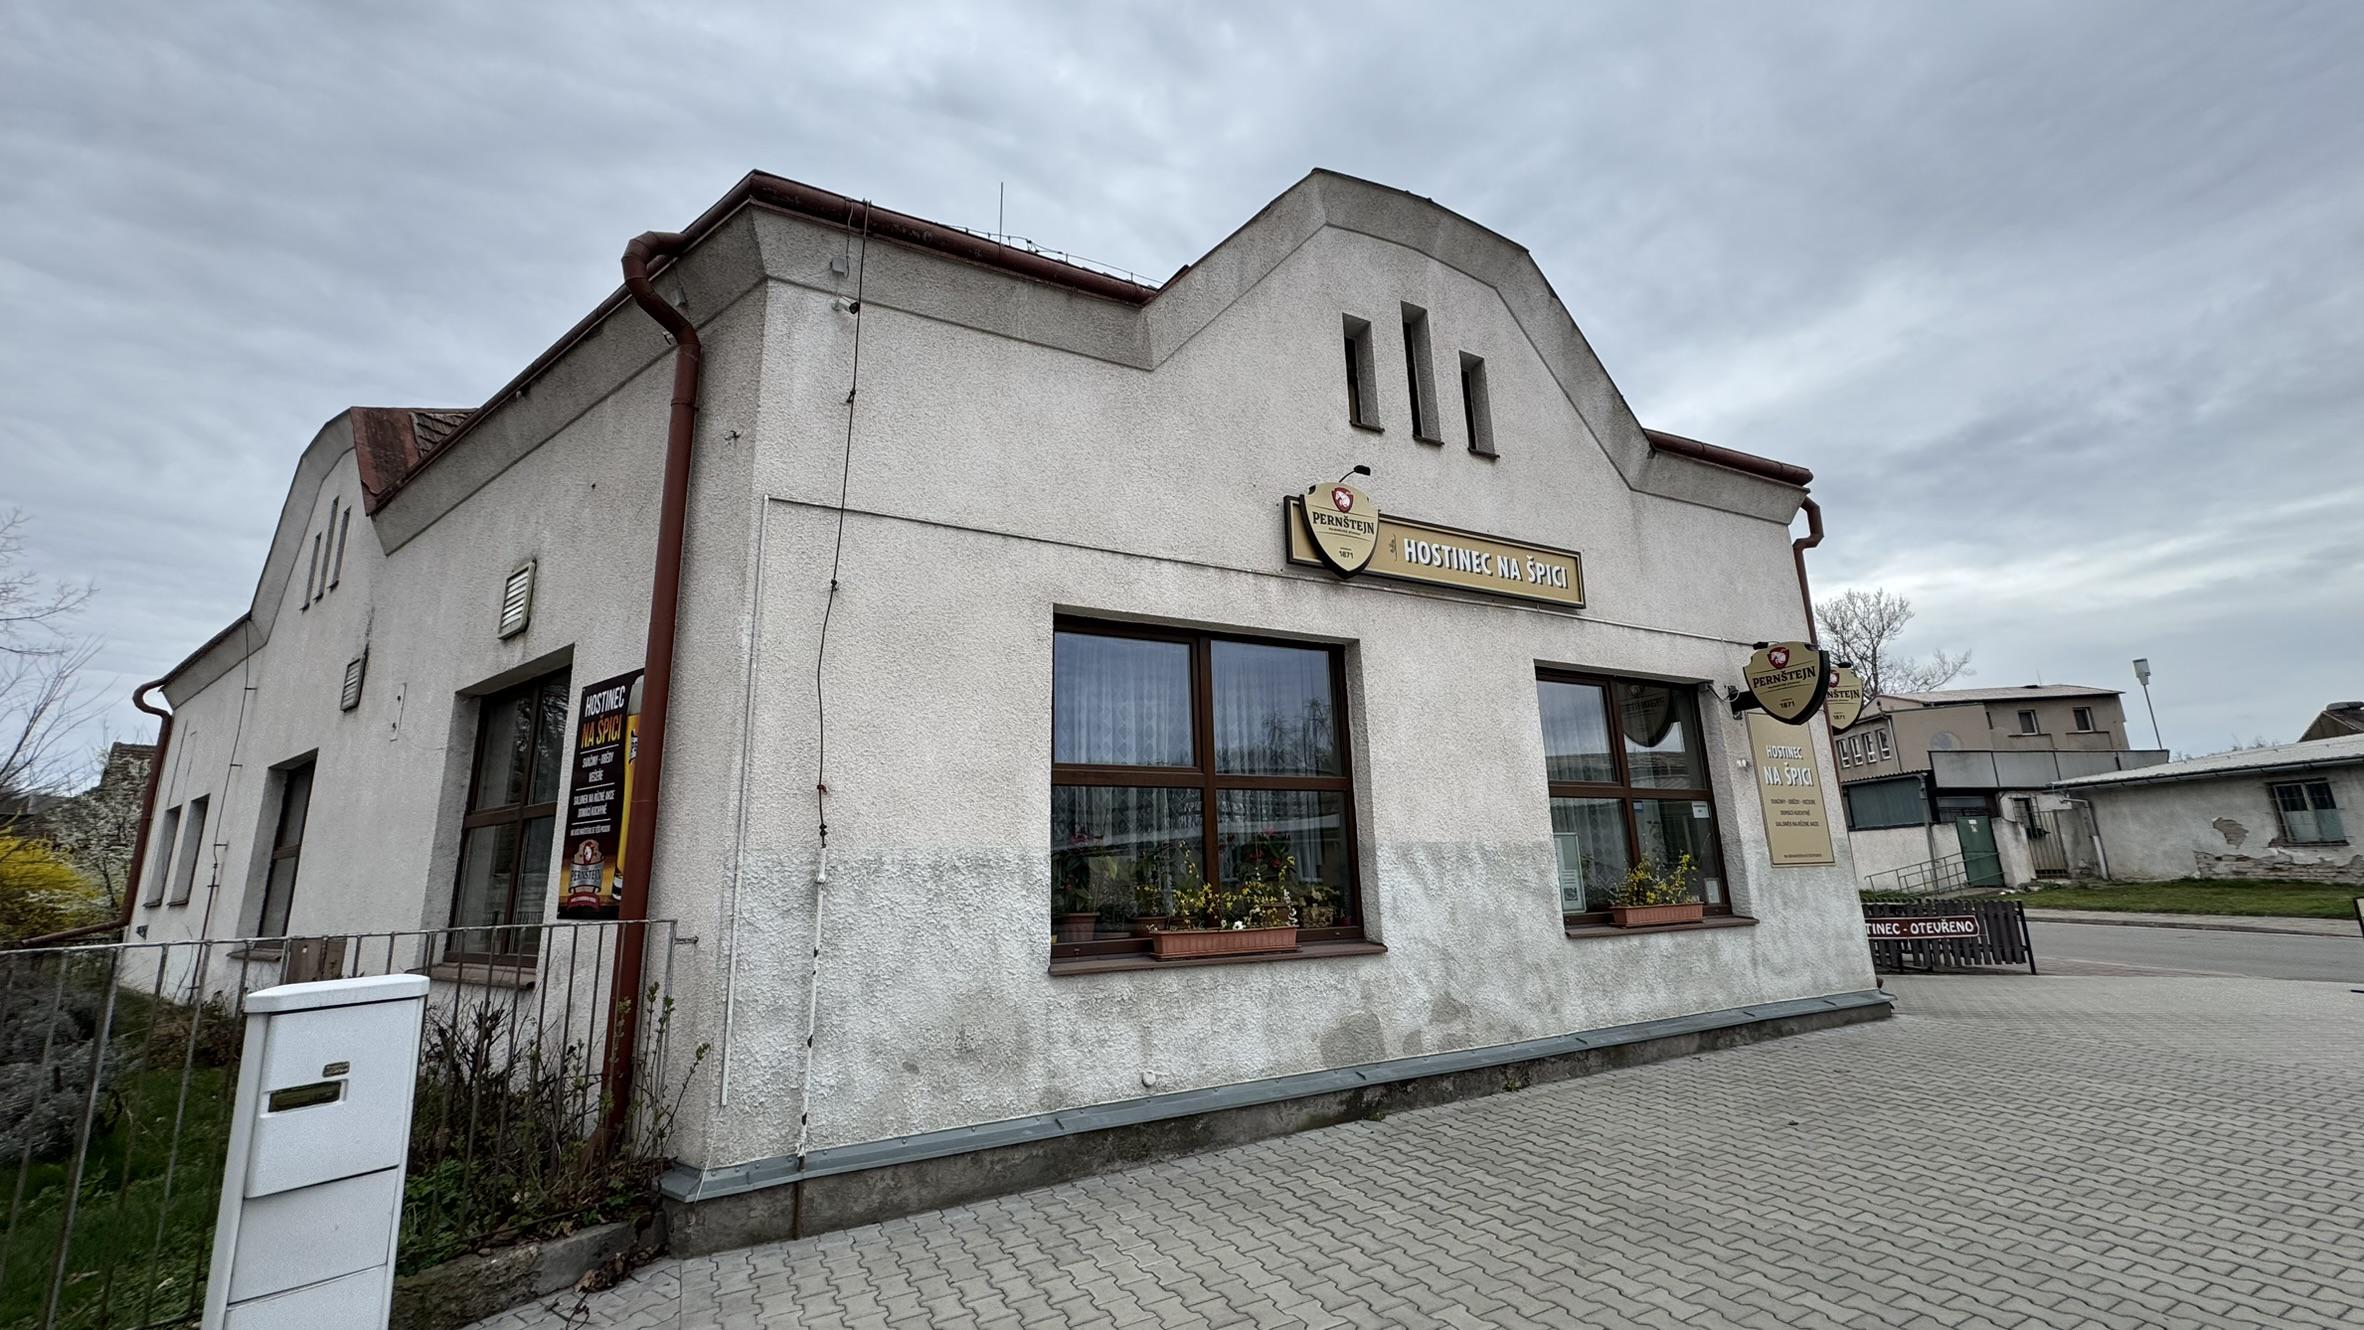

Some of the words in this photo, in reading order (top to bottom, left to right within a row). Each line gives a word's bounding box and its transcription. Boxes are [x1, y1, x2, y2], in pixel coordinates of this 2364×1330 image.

[1312, 511, 1375, 535] PERNŠTEJN
[1339, 550, 1354, 559] 1871
[1404, 537, 1493, 577] HOSTINEC
[1497, 555, 1522, 582] NA
[1527, 555, 1569, 589] ŠPICI
[1752, 665, 1816, 689] PERNŠTEJN
[584, 685, 626, 718] HOSTINEC
[1779, 700, 1795, 709] 1871
[580, 721, 595, 749] NA
[596, 714, 623, 745] ŠPICI
[1766, 745, 1803, 760] HOSTINEC
[1763, 766, 1783, 786] NA
[1784, 761, 1814, 787] ŠPICI
[1910, 918, 1974, 934] OTEVŘENO
